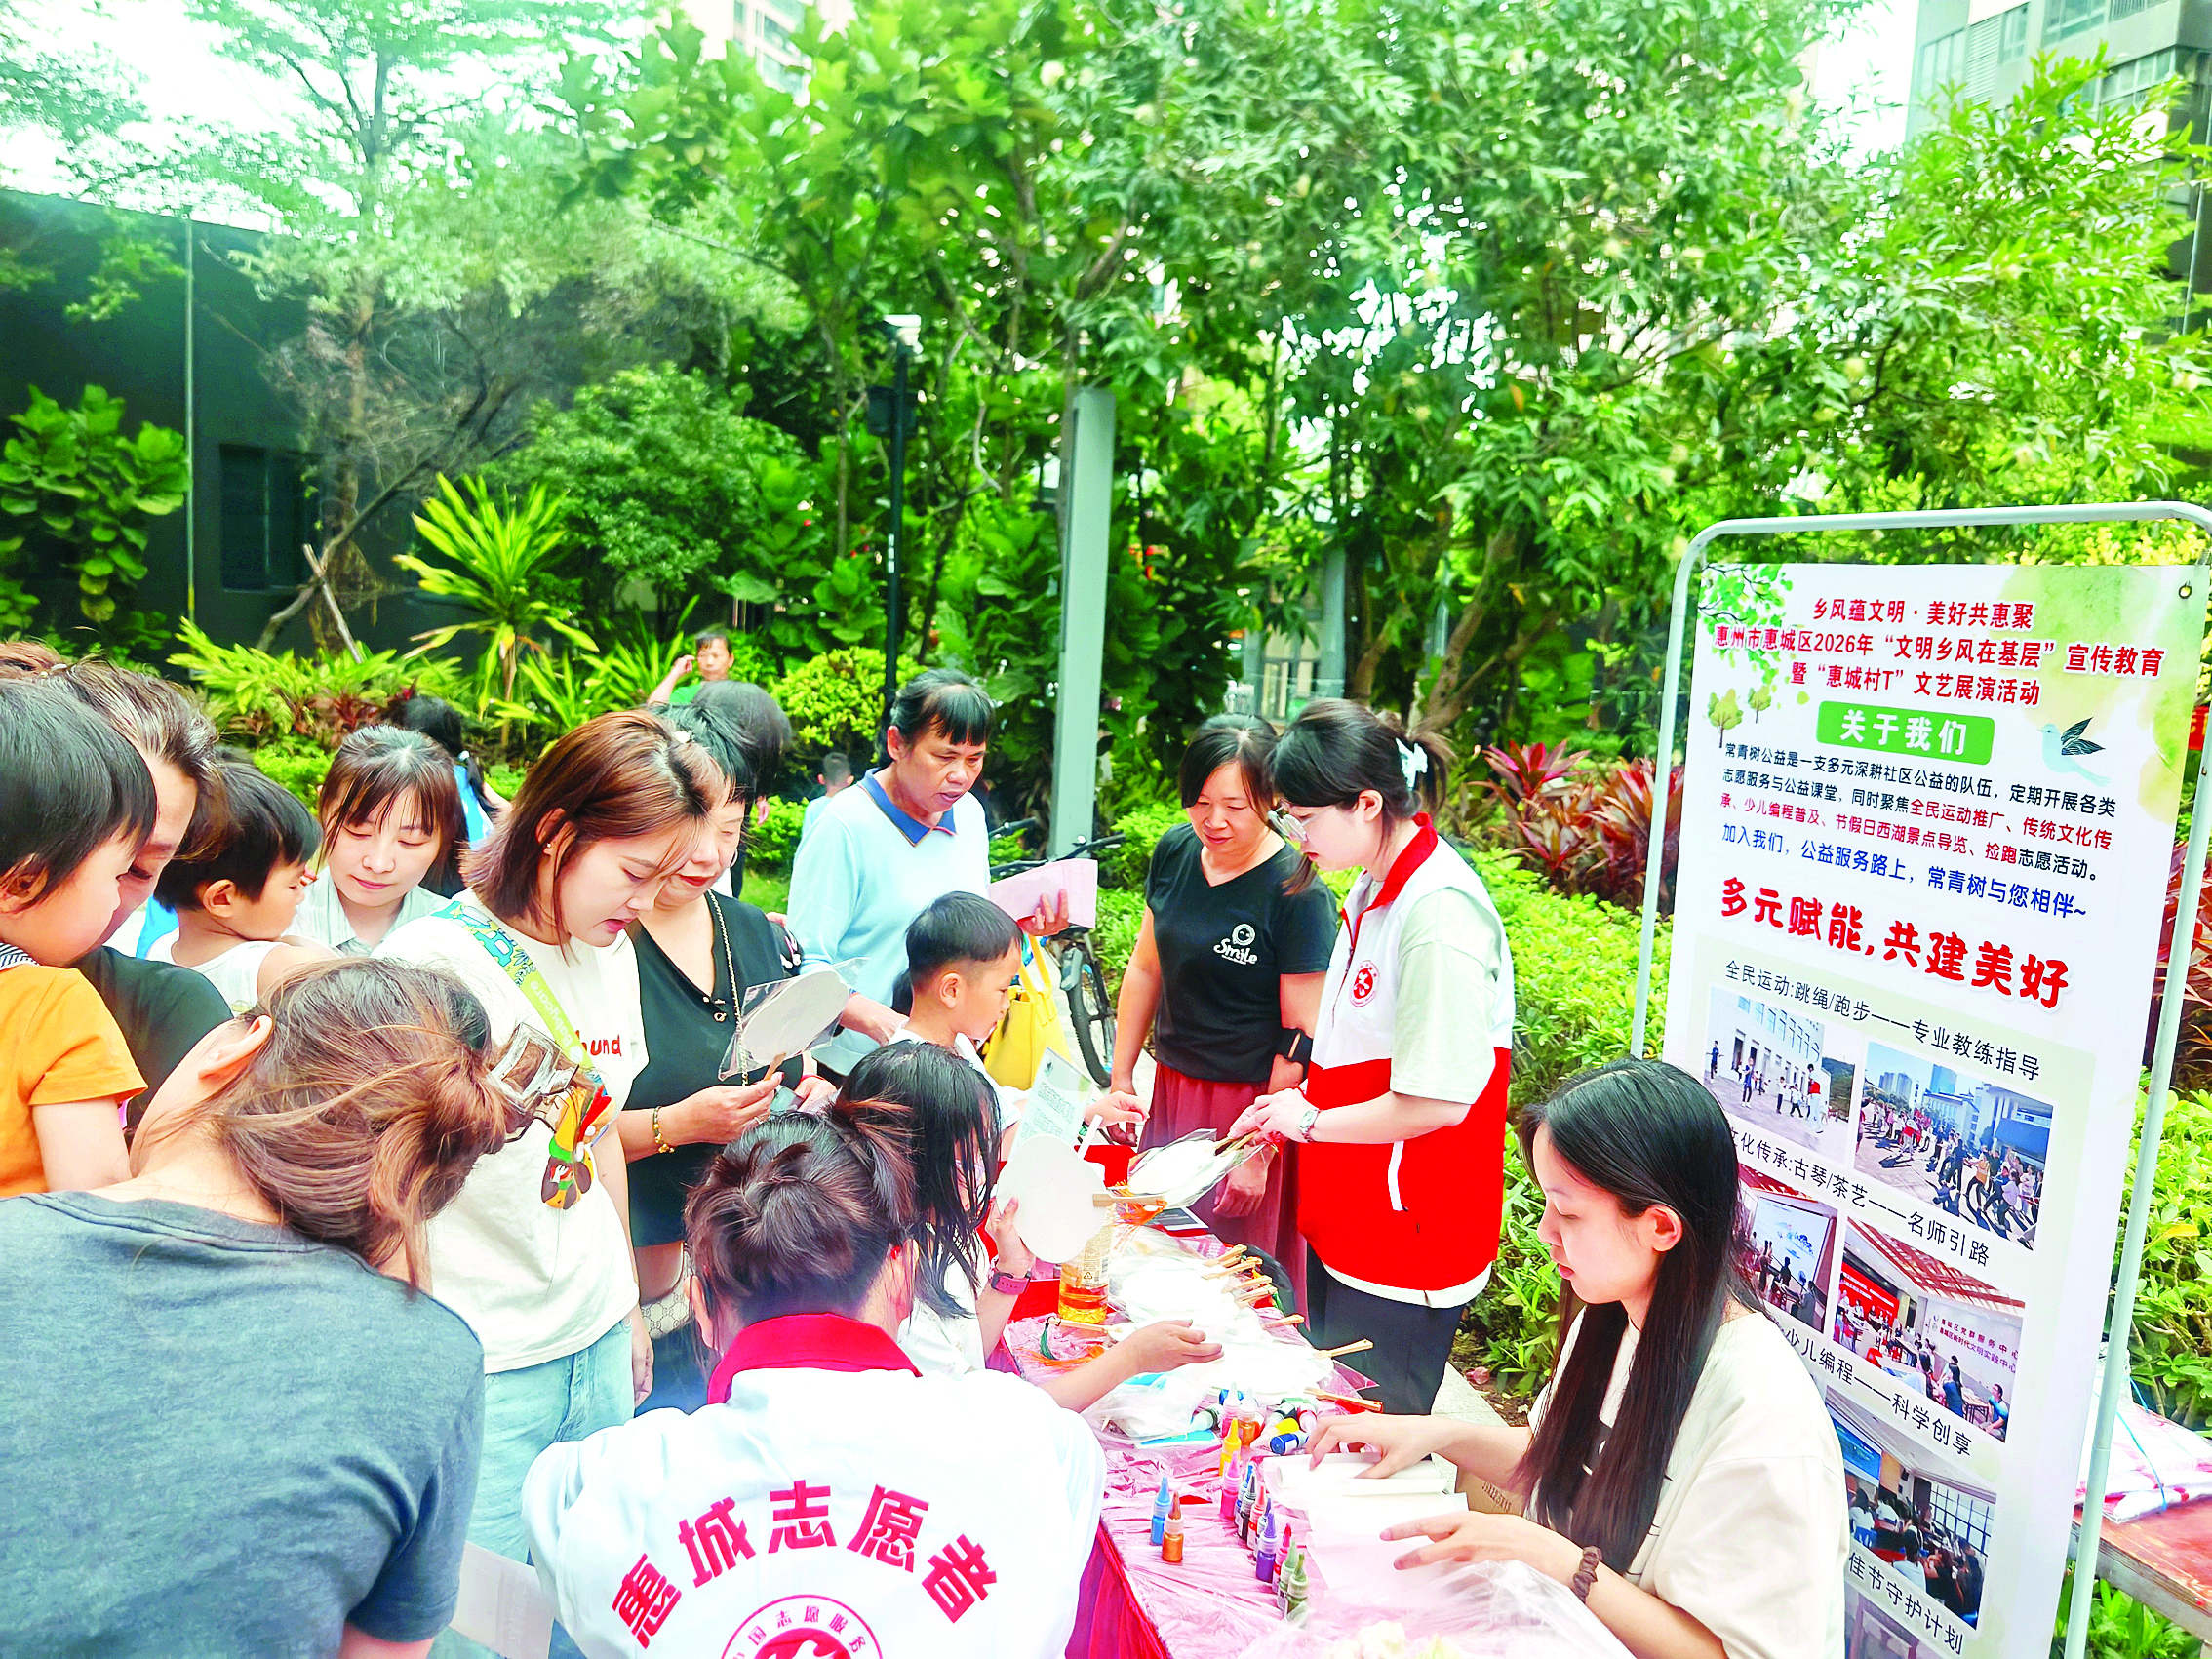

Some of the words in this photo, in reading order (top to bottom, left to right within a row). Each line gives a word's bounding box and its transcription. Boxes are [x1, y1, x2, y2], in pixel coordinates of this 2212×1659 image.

[1813, 598, 2034, 629] 乡风蕴文明·美好共惠聚
[1839, 709, 1967, 756] 关于我们
[1213, 938, 1258, 964] Smile
[530, 980, 573, 1047] Babycare
[612, 1480, 998, 1650] 惠城志愿者
[1848, 1552, 1963, 1655] 佳节守护计划
